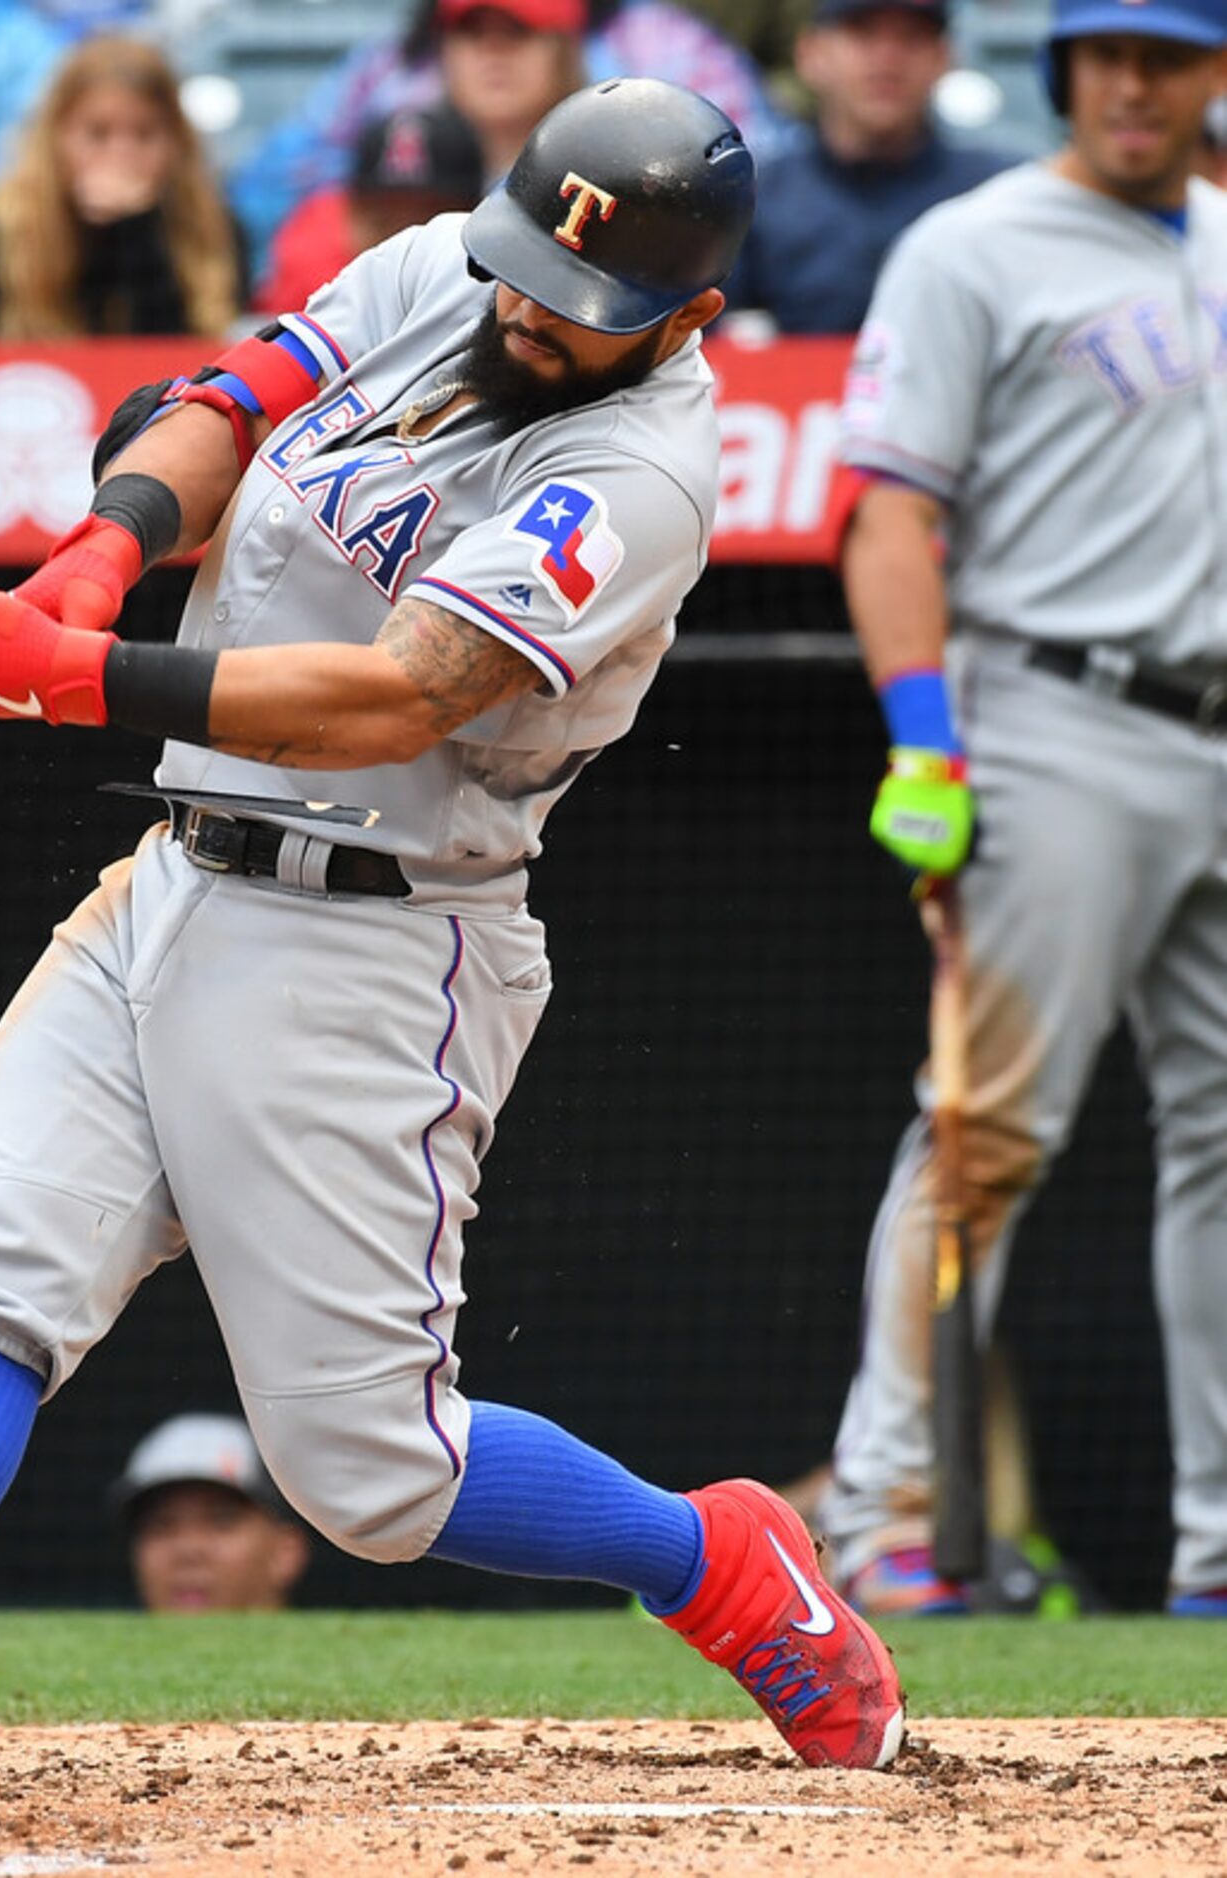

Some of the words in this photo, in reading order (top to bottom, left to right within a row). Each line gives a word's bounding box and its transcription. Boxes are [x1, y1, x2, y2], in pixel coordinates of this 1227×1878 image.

[554, 171, 618, 250] T
[259, 378, 442, 606] EXA
[714, 401, 844, 534] ar
